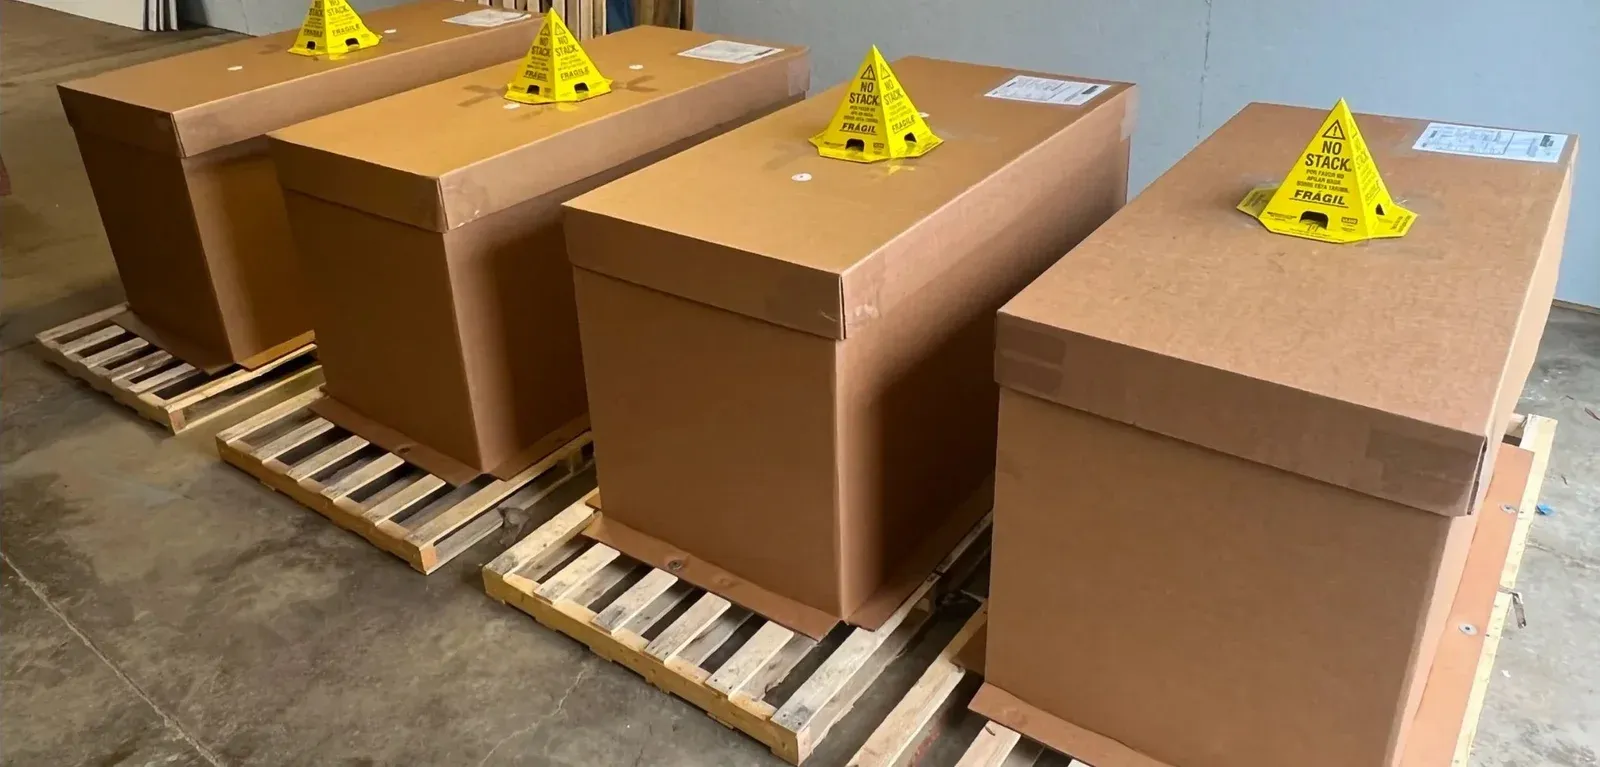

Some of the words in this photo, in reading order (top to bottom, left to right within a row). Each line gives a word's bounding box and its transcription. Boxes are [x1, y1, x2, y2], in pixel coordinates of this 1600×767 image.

[327, 5, 349, 16] STACK
[557, 35, 569, 45] NO
[555, 44, 579, 57] STACK
[560, 66, 590, 80] FRAGILE
[861, 81, 874, 93] NO
[884, 79, 895, 91] NO
[849, 92, 879, 106] STACK
[883, 89, 903, 106] STACK
[841, 122, 876, 134] FRÁGIL
[892, 115, 916, 131] FRAGILE
[1322, 140, 1343, 155] NO
[1305, 153, 1351, 172] STACK
[1294, 189, 1345, 205] FRÁGIL
